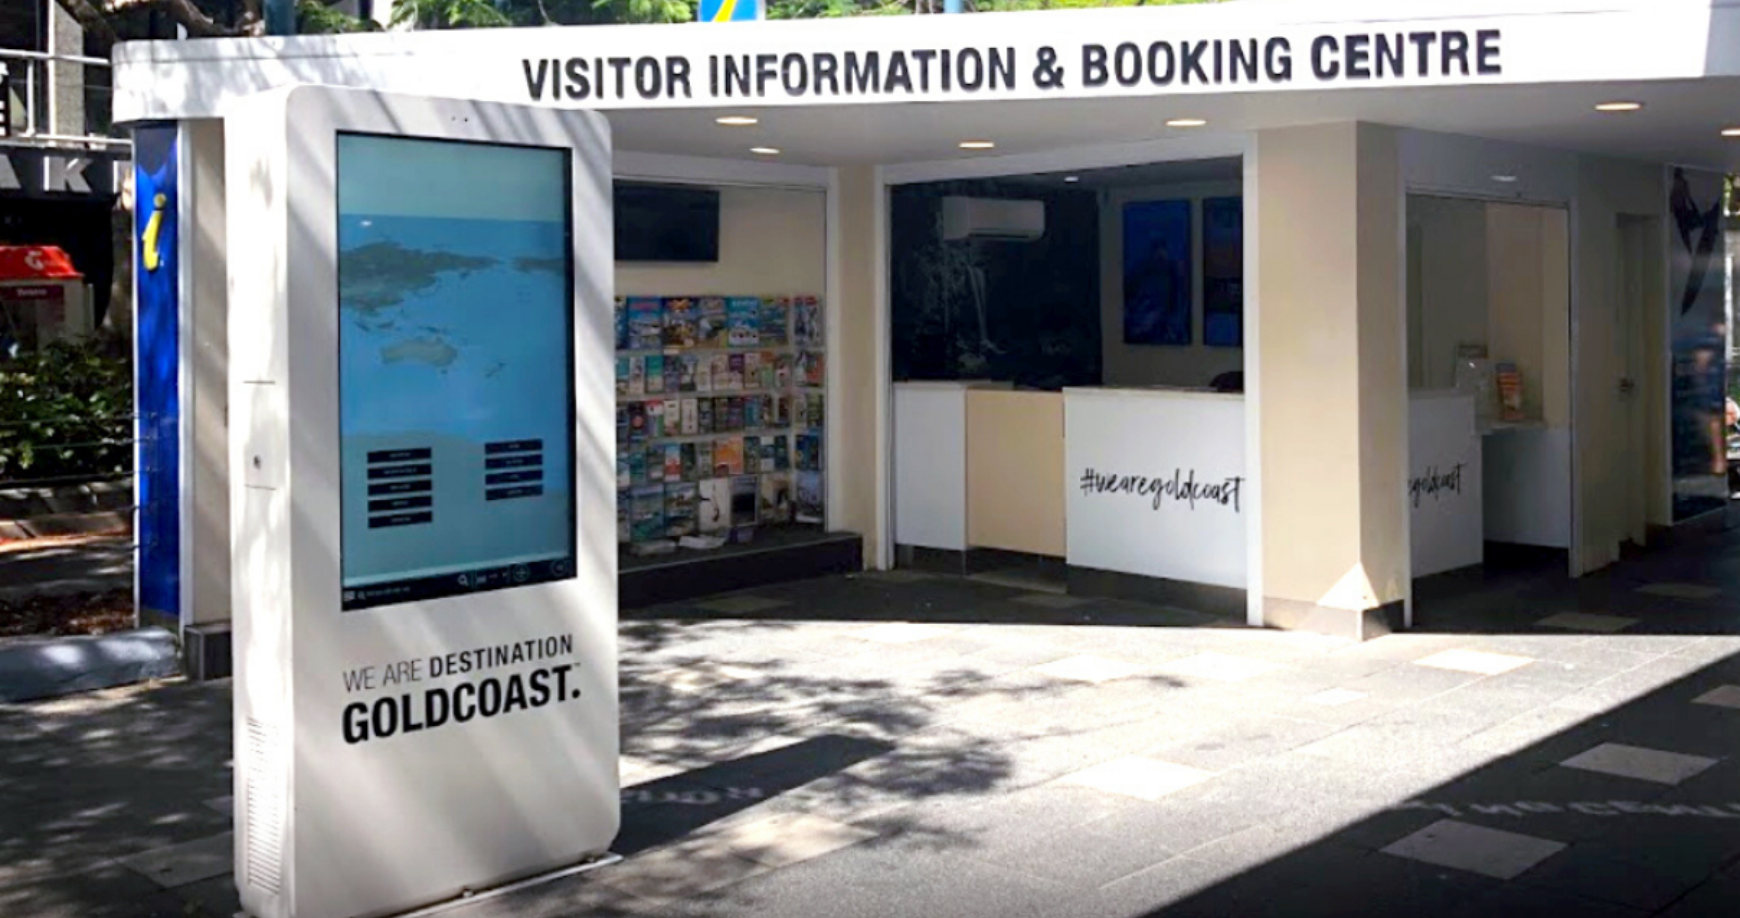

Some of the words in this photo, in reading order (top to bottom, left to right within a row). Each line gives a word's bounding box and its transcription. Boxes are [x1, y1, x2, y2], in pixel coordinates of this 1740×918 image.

[522, 56, 692, 100] VISITOR
[709, 47, 1015, 97] INFORMATION
[1032, 46, 1064, 89] &
[1082, 38, 1292, 86] BOOKING
[1311, 29, 1502, 80] CENTRE
[1079, 467, 1246, 512] #wearegoldcoast
[343, 665, 376, 693] WE
[382, 659, 423, 687] ARE
[429, 634, 574, 679] DESTINATION
